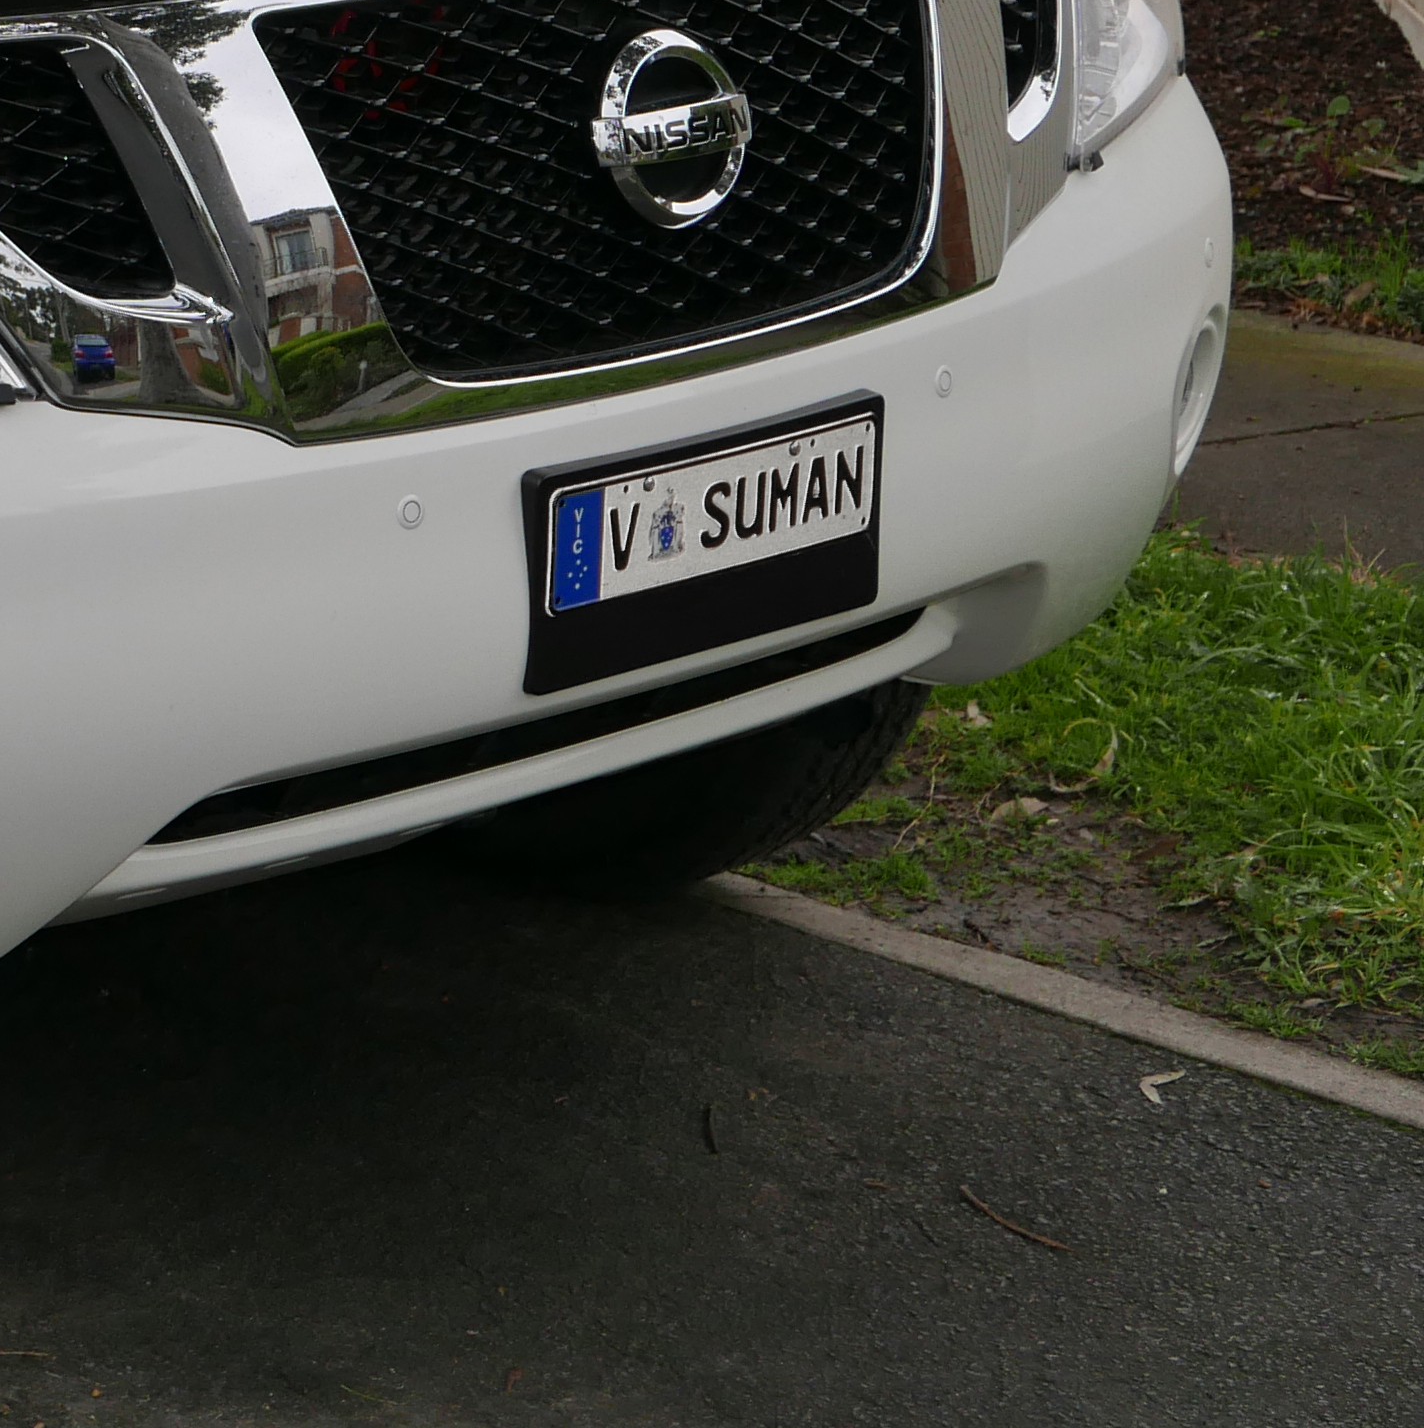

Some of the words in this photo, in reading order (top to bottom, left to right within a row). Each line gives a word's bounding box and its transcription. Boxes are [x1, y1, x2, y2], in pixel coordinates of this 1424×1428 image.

[624, 105, 748, 155] NISSAN
[573, 508, 584, 554] VIC
[609, 502, 640, 571] V
[699, 445, 865, 549] SUMAN
